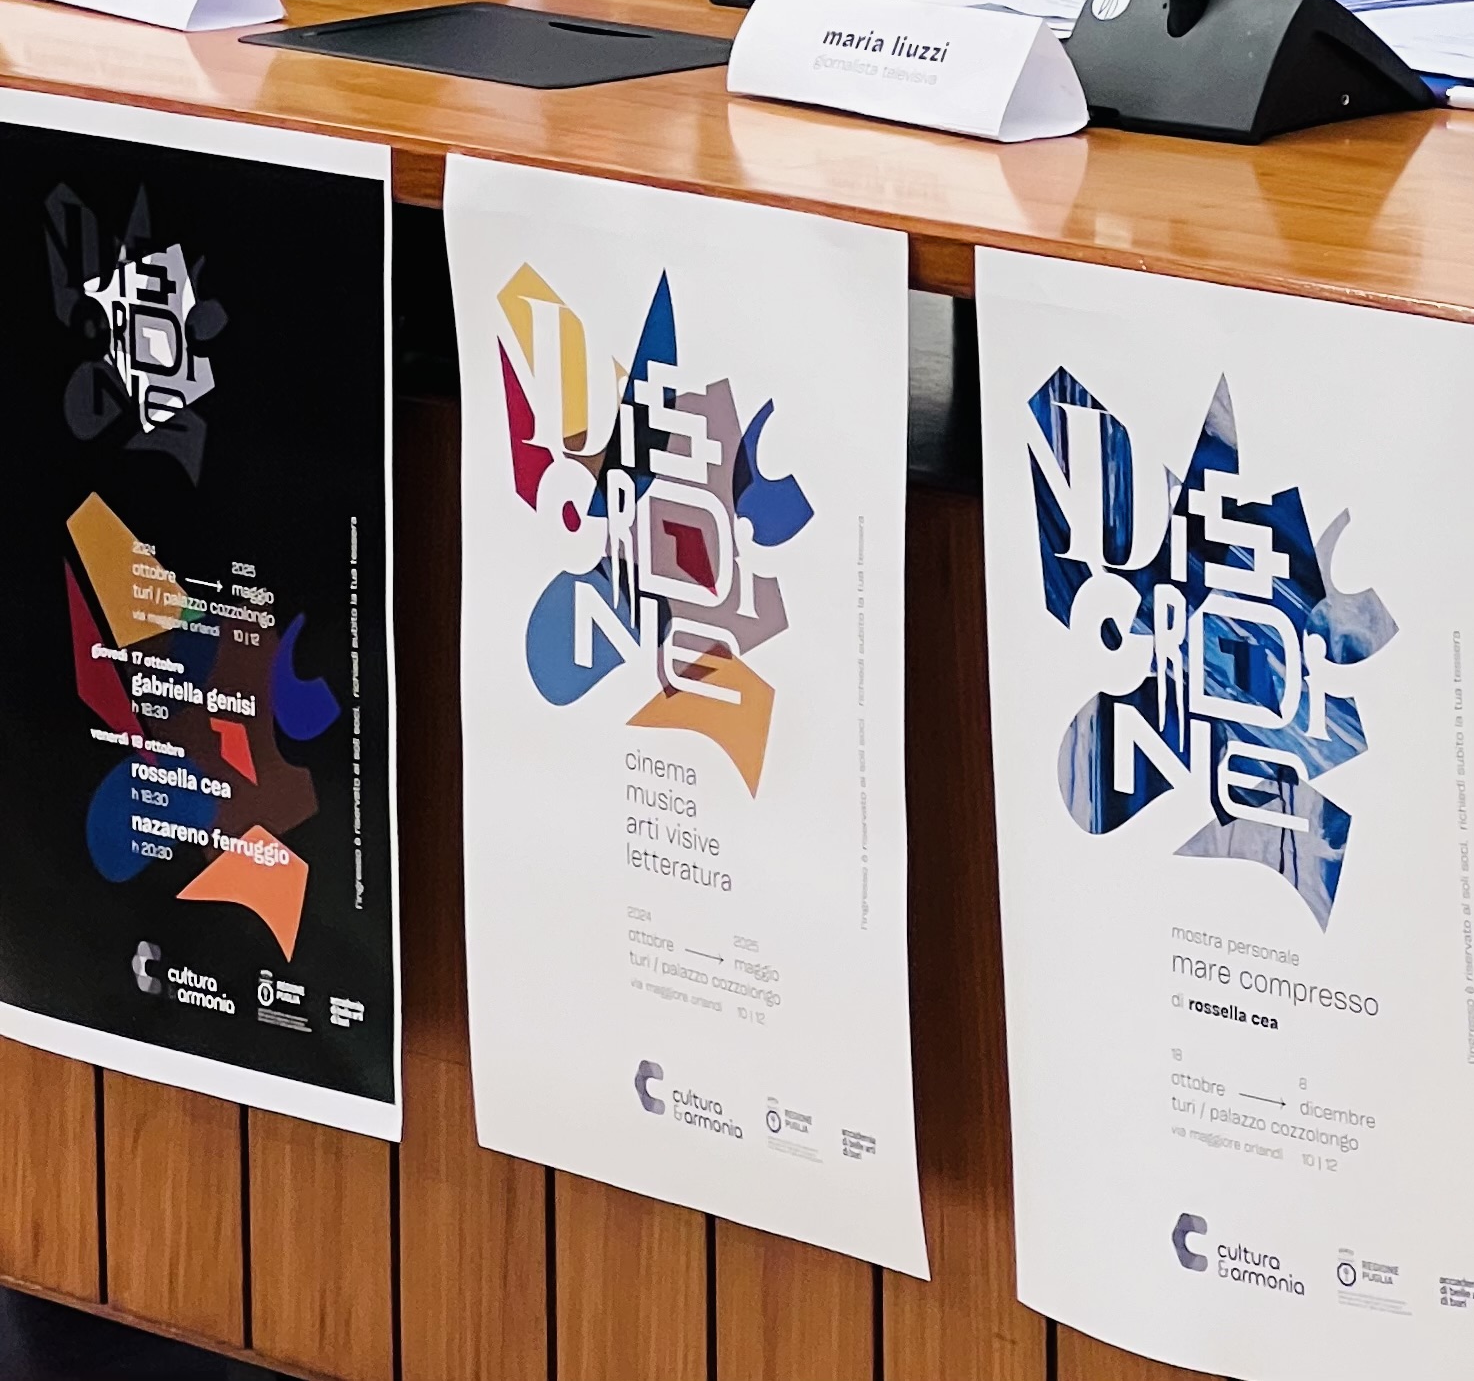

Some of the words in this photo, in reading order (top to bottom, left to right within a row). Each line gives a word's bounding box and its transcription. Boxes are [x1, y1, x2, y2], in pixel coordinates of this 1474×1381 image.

[822, 28, 885, 54] maria
[892, 36, 951, 64] liuzzi
[813, 54, 879, 75] giornalista
[882, 65, 937, 87] televisiva
[132, 563, 176, 583] ottobre
[132, 585, 155, 602] turi
[163, 591, 207, 612] palazzo
[231, 583, 275, 605] maggio
[132, 652, 142, 665] 17
[144, 654, 185, 673] ottobre
[1451, 630, 1464, 683] tessera
[131, 673, 203, 704] gabriella
[207, 692, 256, 717] genisi
[132, 701, 139, 713] h
[144, 738, 185, 758] ottobre
[1454, 732, 1466, 775] subito
[131, 762, 198, 790] rossella
[200, 776, 231, 798] cea
[625, 750, 698, 786] cinema
[132, 788, 139, 801] h
[626, 782, 697, 817] musica
[1455, 779, 1469, 830] richiedi
[131, 814, 209, 847] nazareno
[212, 829, 289, 867] ferruggio
[626, 814, 659, 840] arti
[665, 822, 720, 856] visive
[141, 843, 173, 861] 20:30
[626, 843, 733, 892] letteratura
[1460, 875, 1472, 899] soli
[628, 927, 674, 953] ottobre
[1171, 925, 1223, 950] mostra
[1227, 937, 1300, 968] personale
[1461, 920, 1474, 981] riservato
[167, 966, 218, 992] cultura
[629, 950, 652, 969] turi
[662, 960, 709, 986] palazzo
[711, 974, 782, 1008] cozzolongo
[734, 957, 780, 983] maggio
[1171, 952, 1232, 986] mare
[1238, 967, 1380, 1018] compresso
[1171, 992, 1185, 1009] di
[1188, 997, 1247, 1023] rossella
[1250, 1010, 1279, 1032] cea
[1171, 1047, 1183, 1062] 18
[1171, 1070, 1226, 1098] ottobre
[1298, 1077, 1307, 1091] 8
[673, 1089, 723, 1116] cultura
[1299, 1099, 1377, 1129] dicembre
[1171, 1096, 1197, 1116] turi
[1209, 1105, 1267, 1132] palazzo
[1270, 1117, 1360, 1153] cozzolongo
[1301, 1152, 1314, 1168] 10
[1325, 1157, 1338, 1173] 12
[1217, 1243, 1280, 1271] cultura
